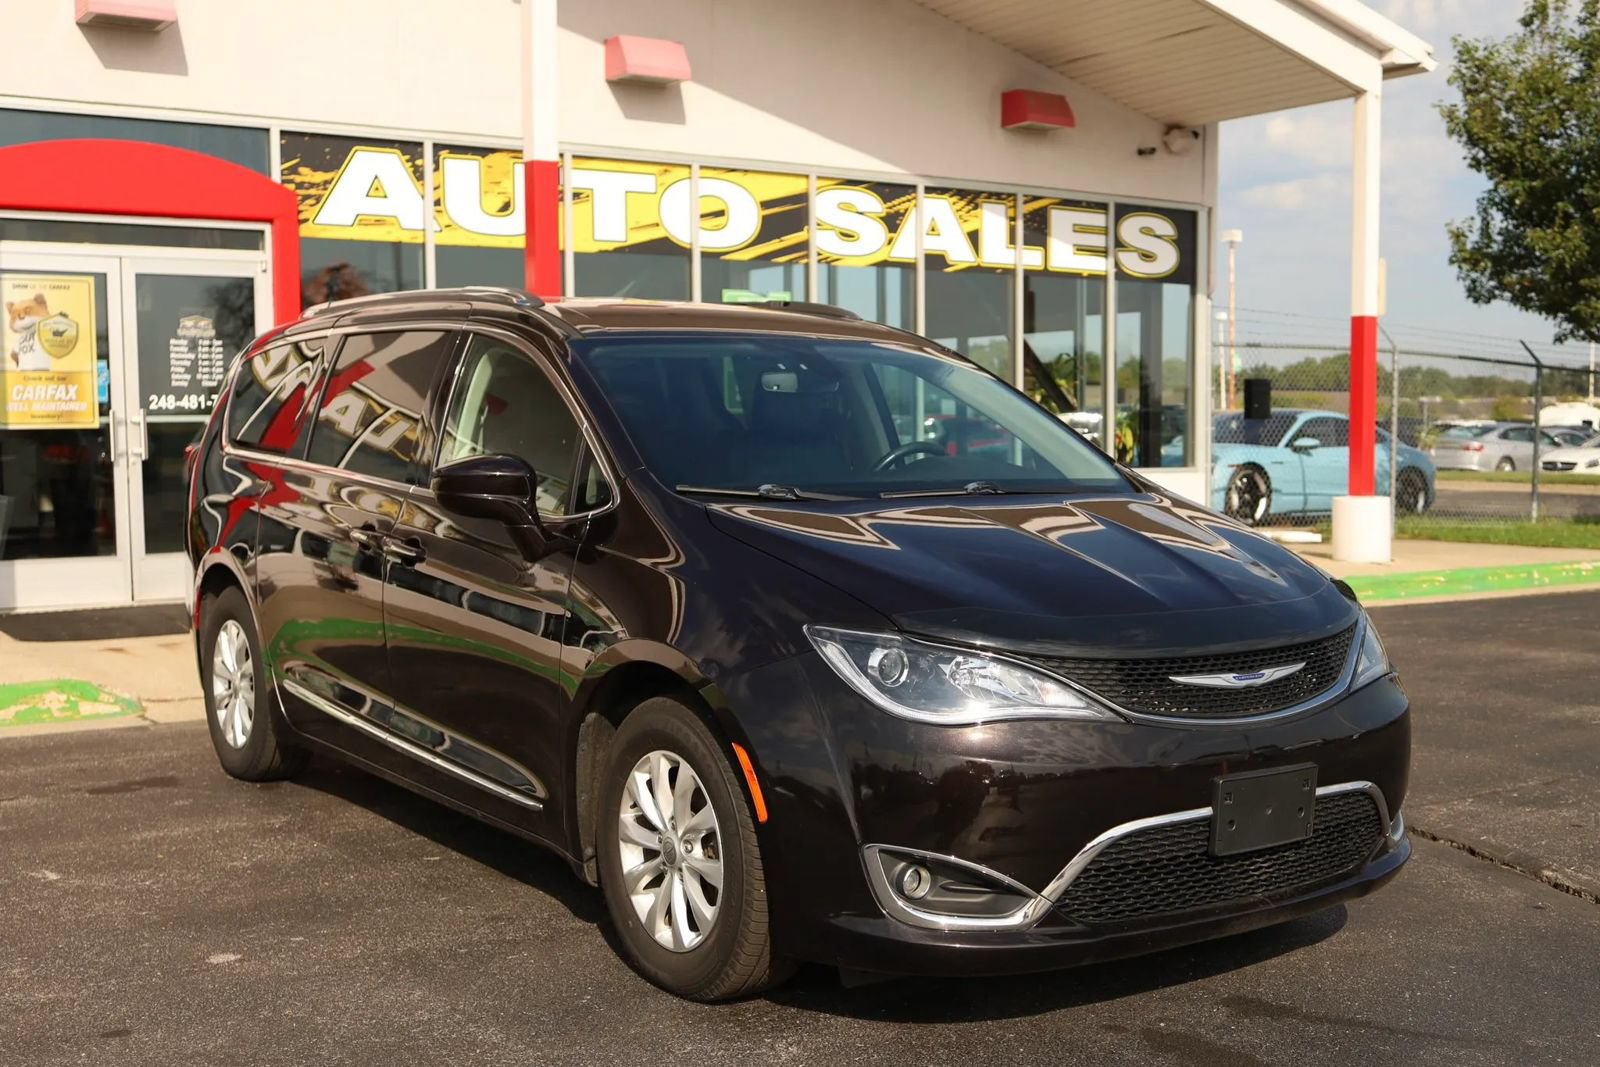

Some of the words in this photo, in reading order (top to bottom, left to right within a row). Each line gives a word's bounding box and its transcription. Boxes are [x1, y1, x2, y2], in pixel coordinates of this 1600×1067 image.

[312, 146, 761, 250] AUTO
[807, 186, 1180, 278] SALES
[12, 384, 78, 401] CARFAX
